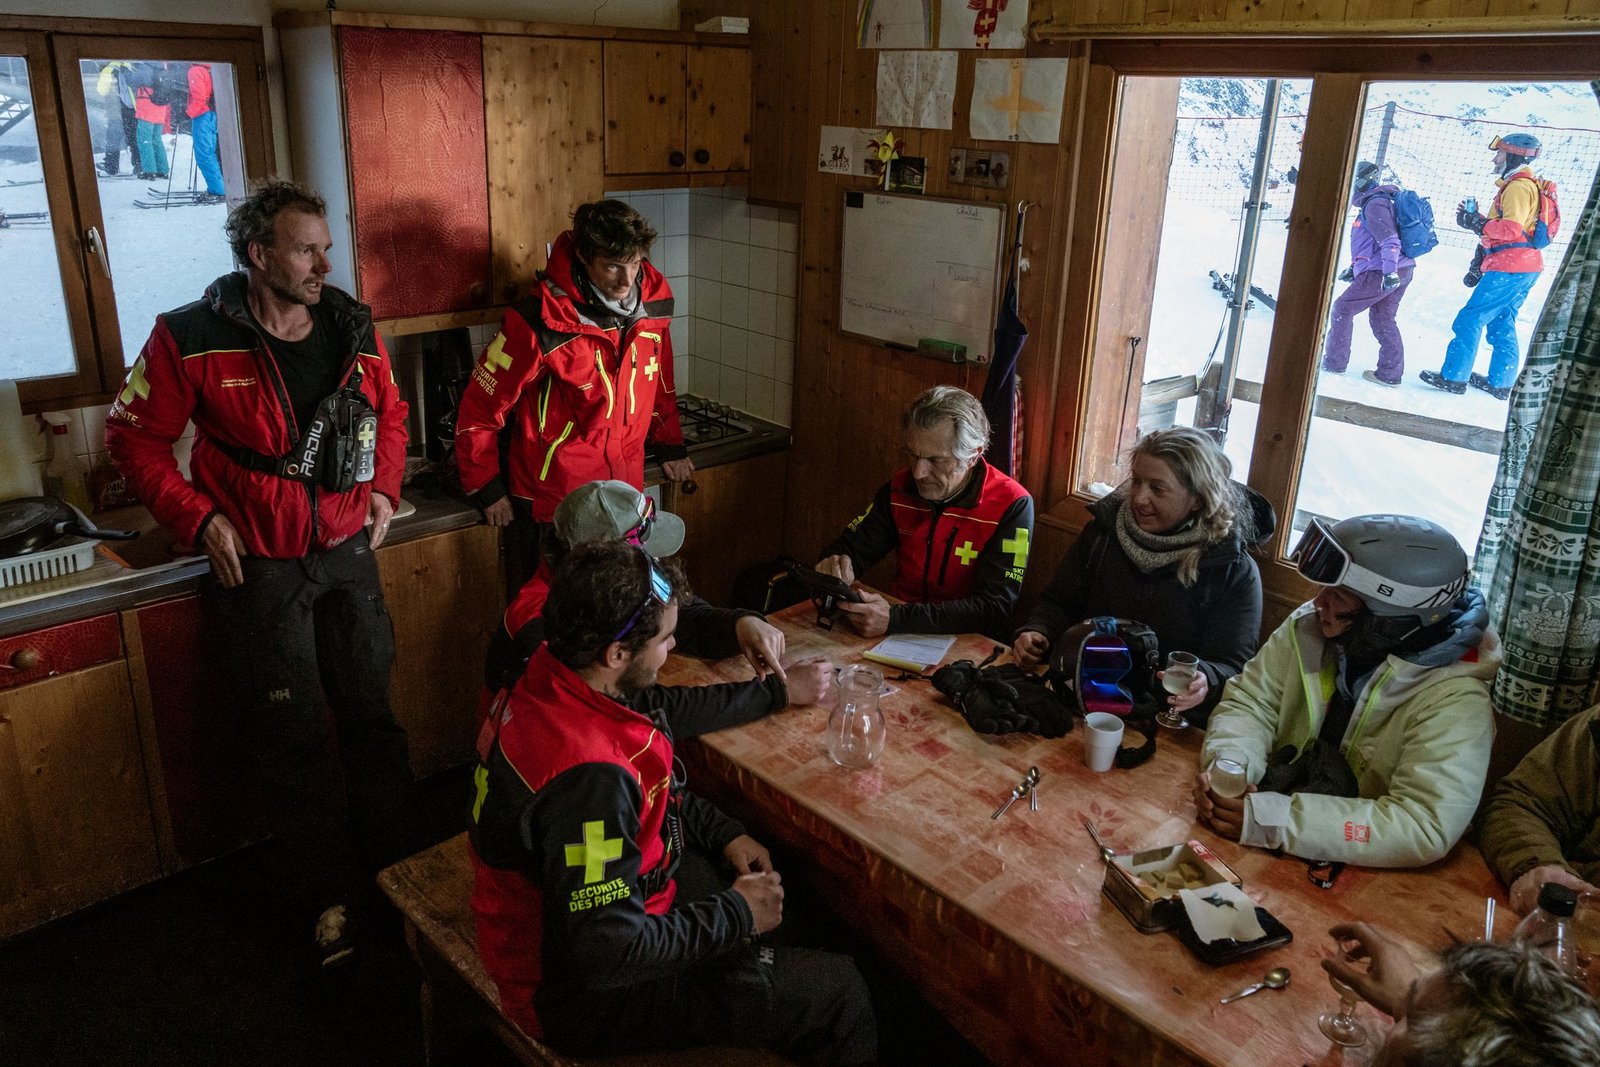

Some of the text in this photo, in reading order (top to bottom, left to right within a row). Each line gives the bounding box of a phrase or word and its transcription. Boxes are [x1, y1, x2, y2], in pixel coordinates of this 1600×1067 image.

[475, 375, 496, 396] PISTES
[1012, 567, 1024, 576] SKI
[568, 886, 631, 913] DES PISTES
[570, 877, 626, 901] SECURITE
